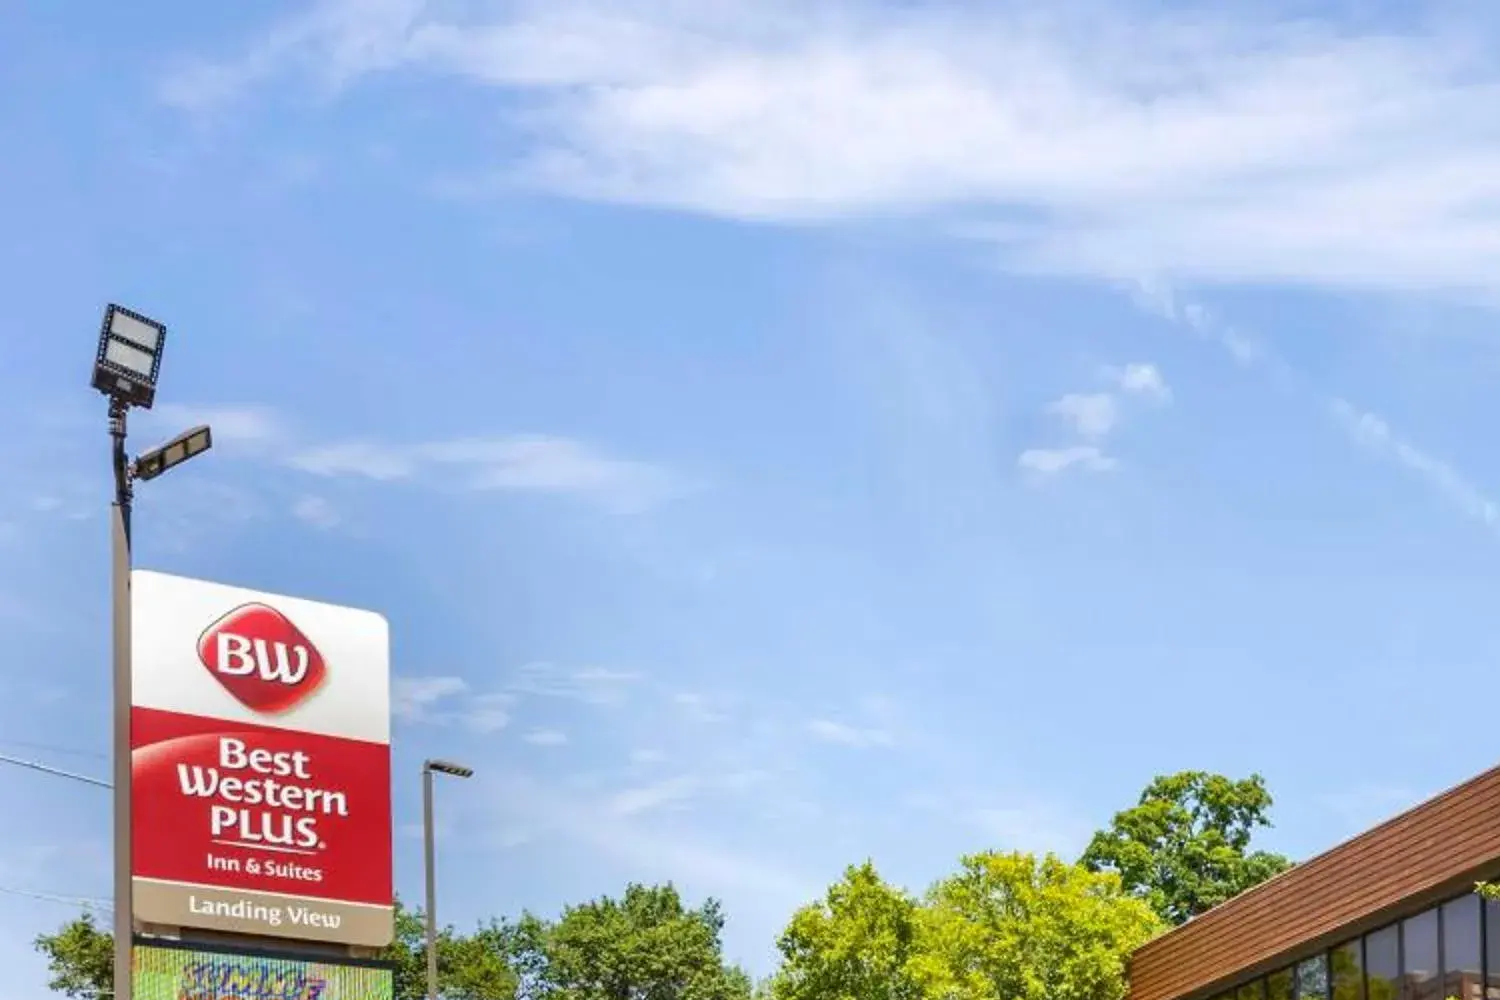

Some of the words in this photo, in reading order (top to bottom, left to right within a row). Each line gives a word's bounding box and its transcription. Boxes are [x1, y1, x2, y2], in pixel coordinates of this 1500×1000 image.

[217, 631, 308, 685] BW
[219, 737, 312, 779] Best
[177, 763, 348, 816] Western
[207, 853, 240, 872] Inn
[245, 857, 262, 875] &
[264, 860, 323, 882] Suites
[189, 895, 283, 926] Landing
[287, 905, 341, 929] View
